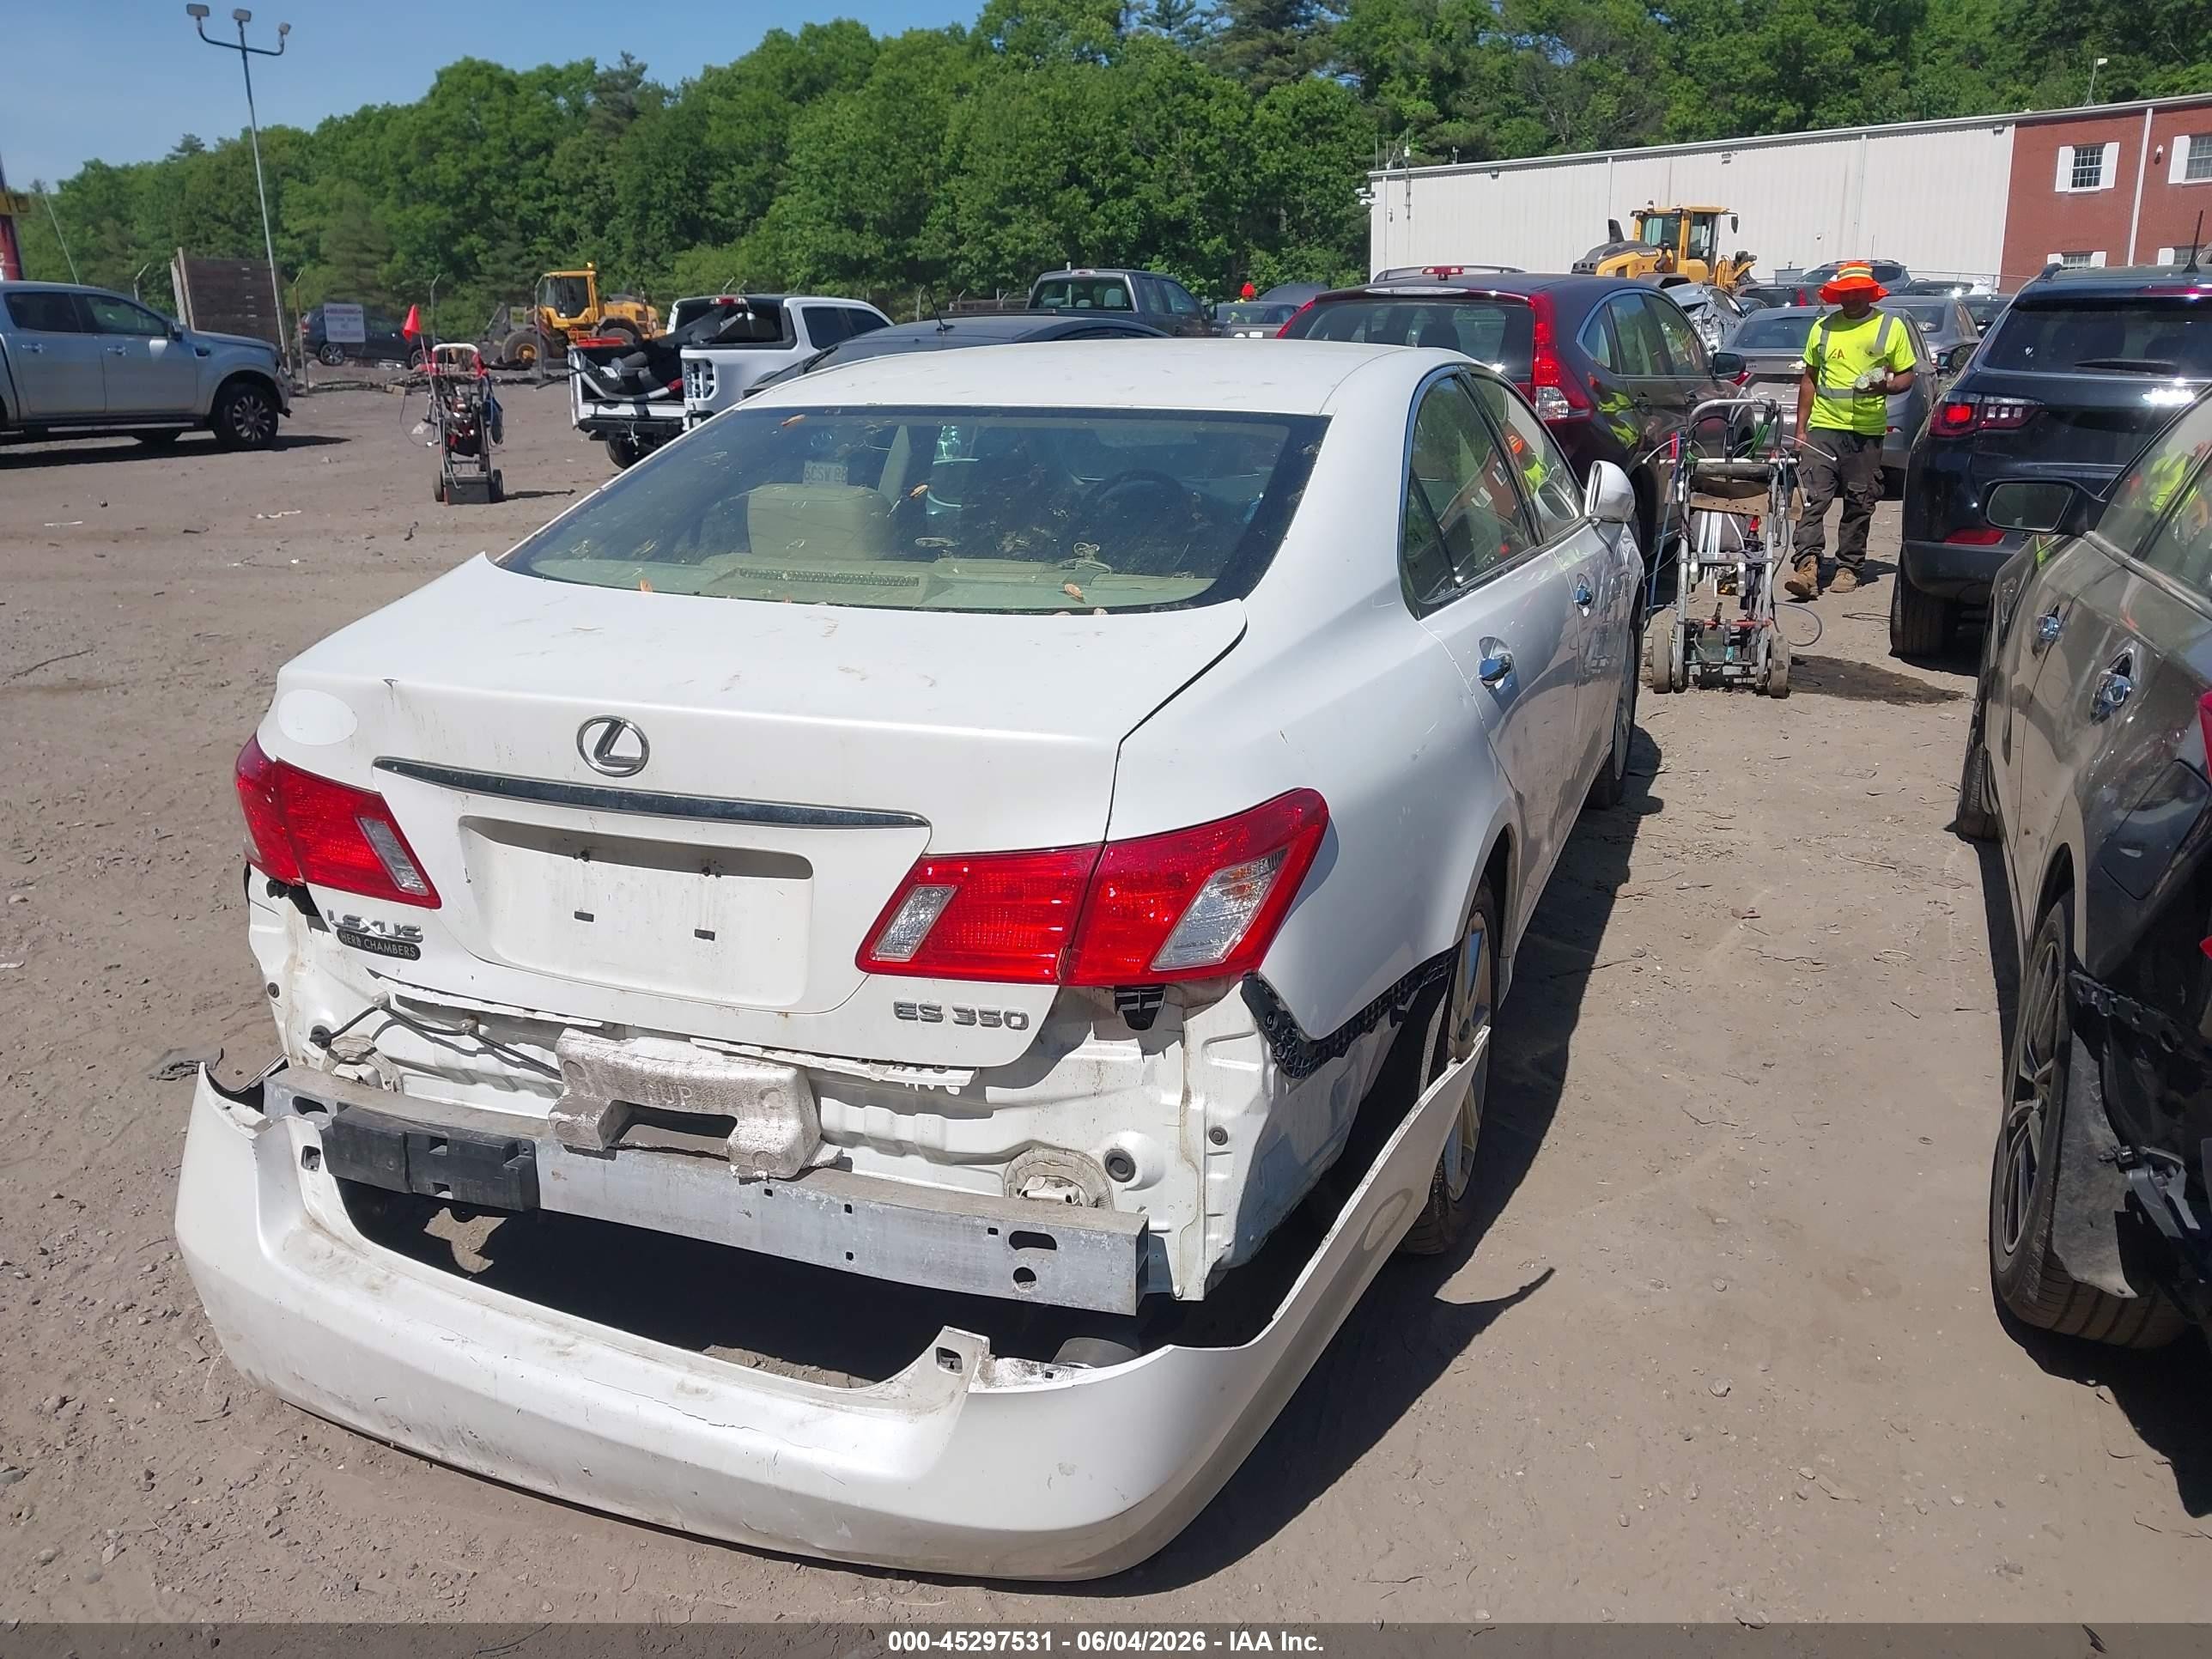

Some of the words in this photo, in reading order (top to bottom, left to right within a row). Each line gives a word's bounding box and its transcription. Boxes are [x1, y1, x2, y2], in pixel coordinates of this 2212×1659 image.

[326, 908, 424, 944] LEXUS
[340, 931, 362, 948] HERB
[363, 938, 416, 958] CHAMBERS
[893, 1000, 944, 1023] ES
[951, 1005, 1030, 1030] 350
